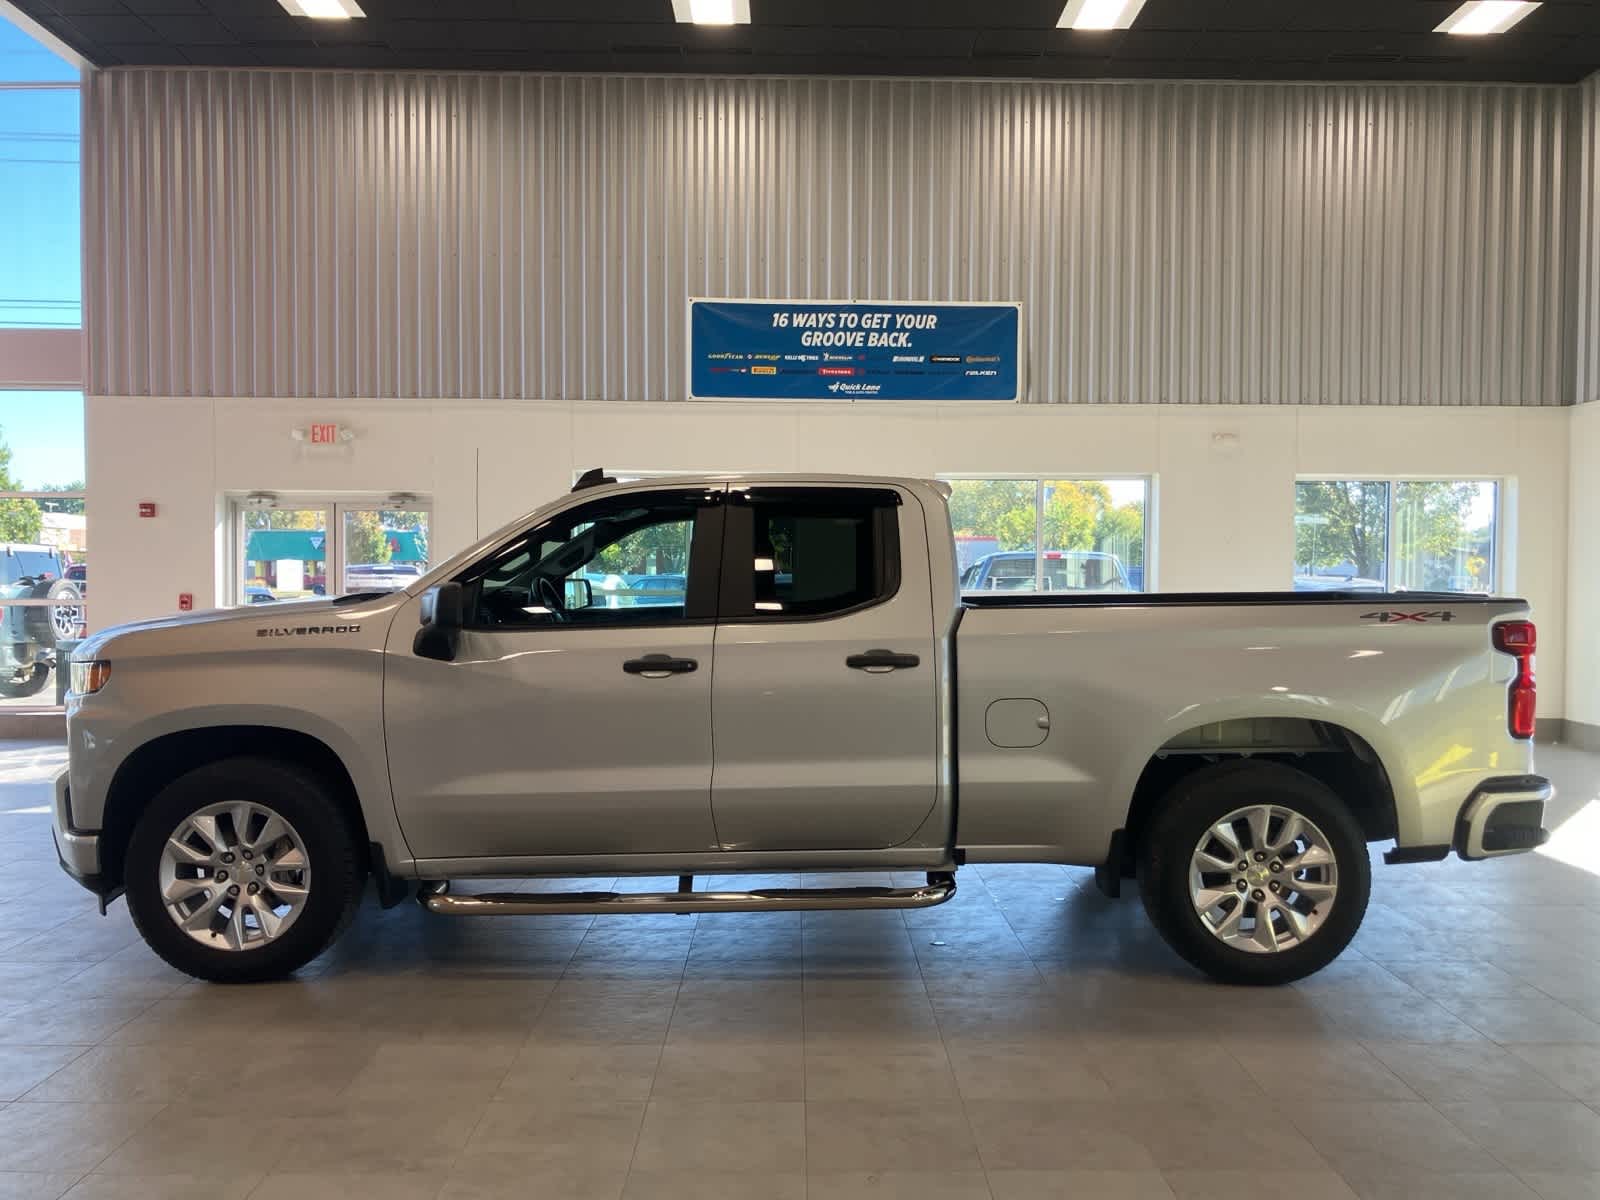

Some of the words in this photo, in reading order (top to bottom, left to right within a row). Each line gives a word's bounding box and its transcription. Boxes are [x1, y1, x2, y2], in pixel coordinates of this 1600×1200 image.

[772, 312, 789, 328] 16
[793, 312, 836, 328] WAYS
[839, 313, 858, 329] TO
[861, 313, 892, 329] GET
[895, 314, 938, 329] YOUR
[801, 331, 865, 347] GROOVE
[868, 331, 913, 348] BACK.
[840, 383, 861, 391] Quick
[861, 383, 881, 391] Lane
[311, 424, 337, 443] EXIT
[256, 624, 361, 637] SILVERADO
